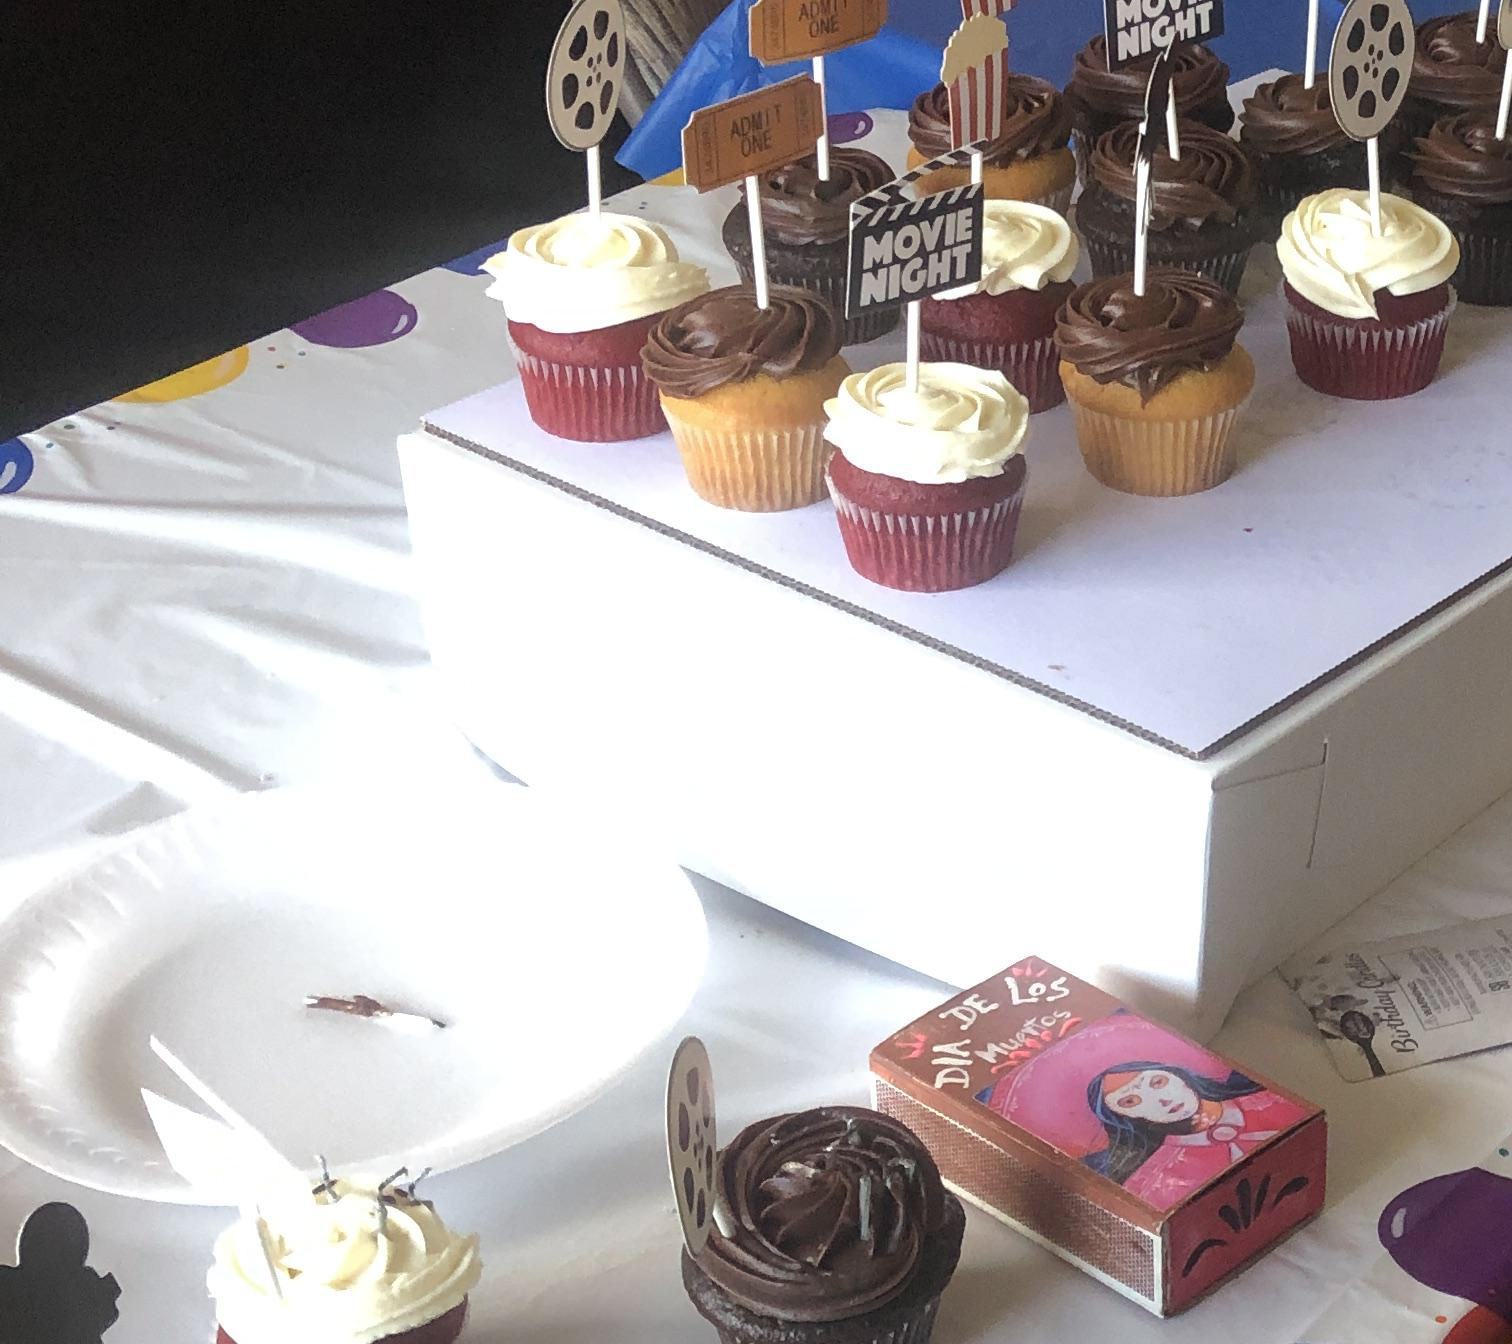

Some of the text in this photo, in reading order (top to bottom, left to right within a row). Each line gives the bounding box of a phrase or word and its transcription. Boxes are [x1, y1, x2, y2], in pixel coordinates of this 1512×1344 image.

[808, 15, 839, 38] ONE
[1117, 0, 1214, 62] NIGHT
[730, 104, 782, 141] ADMIT
[741, 130, 773, 157] ONE
[863, 208, 974, 270] MOVIE
[859, 243, 973, 308] NIGHT
[938, 993, 1000, 1031] DE
[1373, 990, 1418, 1053] Birthday
[930, 1039, 974, 1089] DIA
